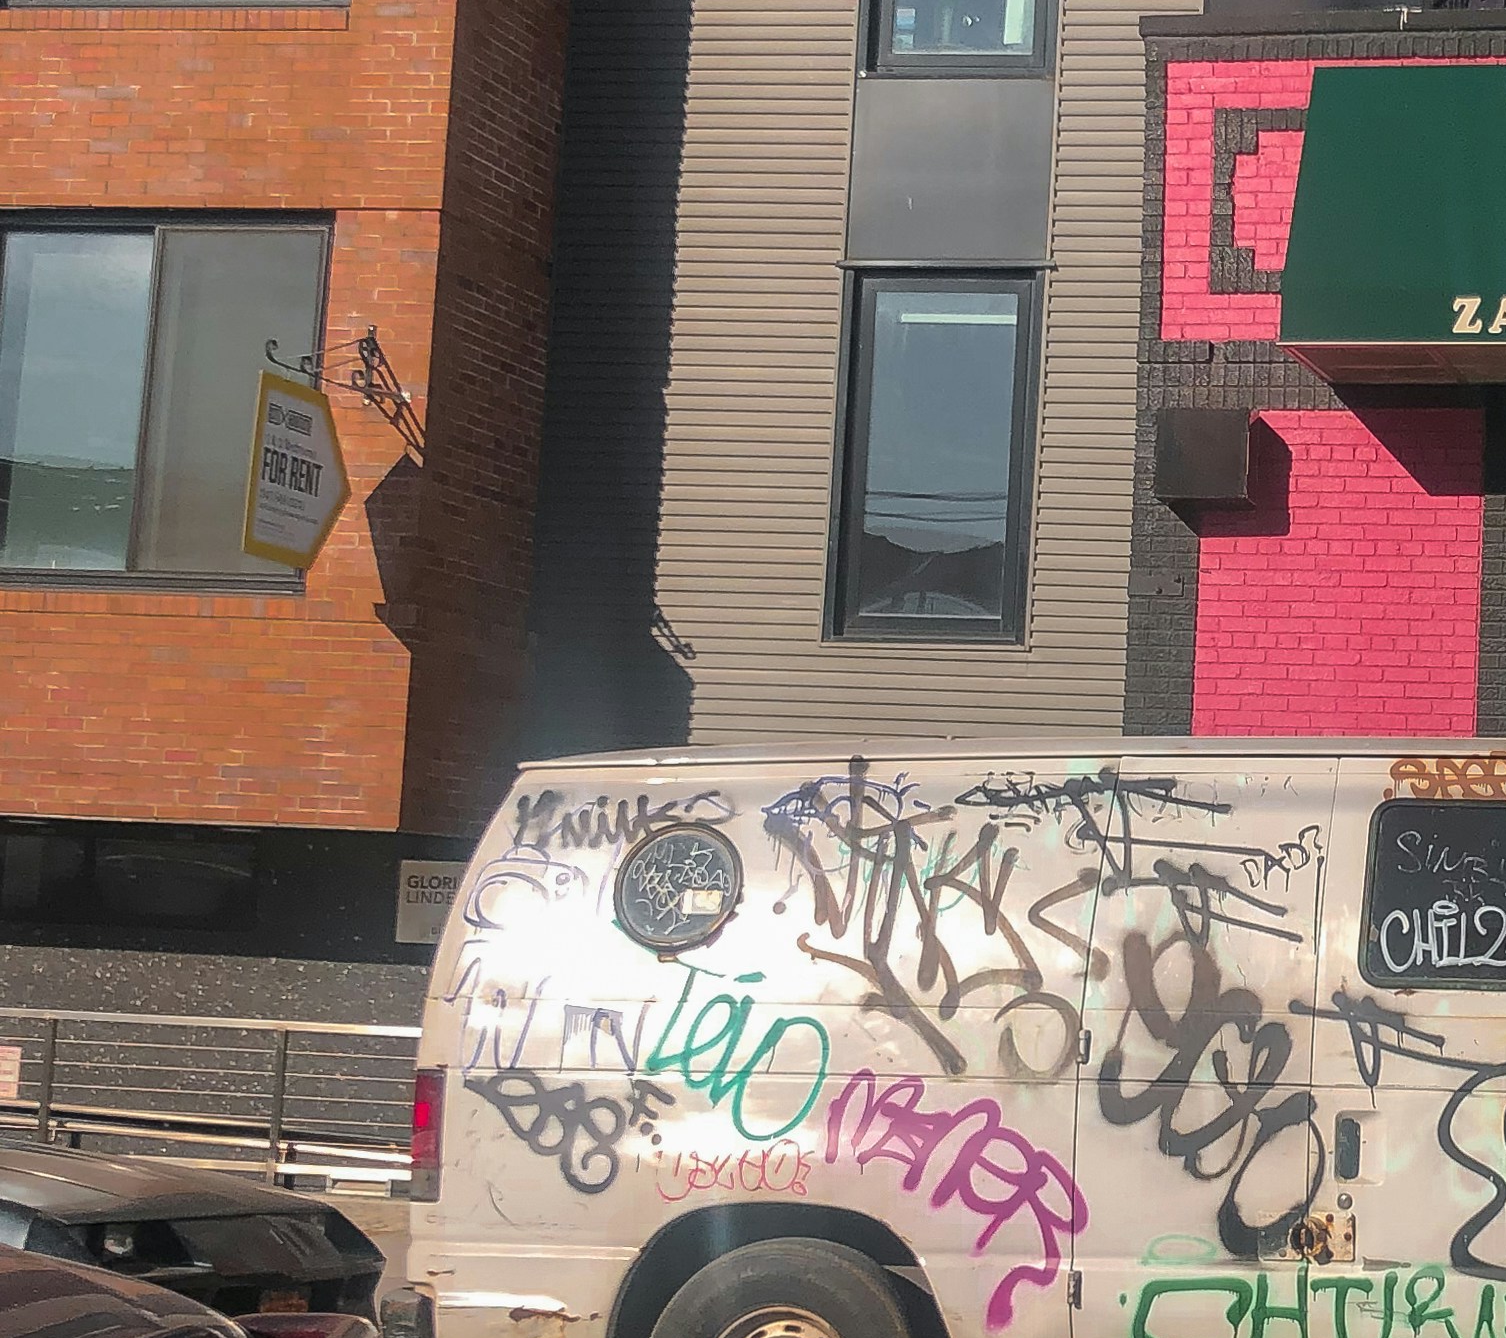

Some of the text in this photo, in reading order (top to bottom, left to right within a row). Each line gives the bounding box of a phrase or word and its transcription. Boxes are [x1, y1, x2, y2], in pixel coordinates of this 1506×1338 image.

[261, 446, 288, 486] FOR
[289, 453, 325, 498] RENT
[407, 874, 458, 890] GLORI
